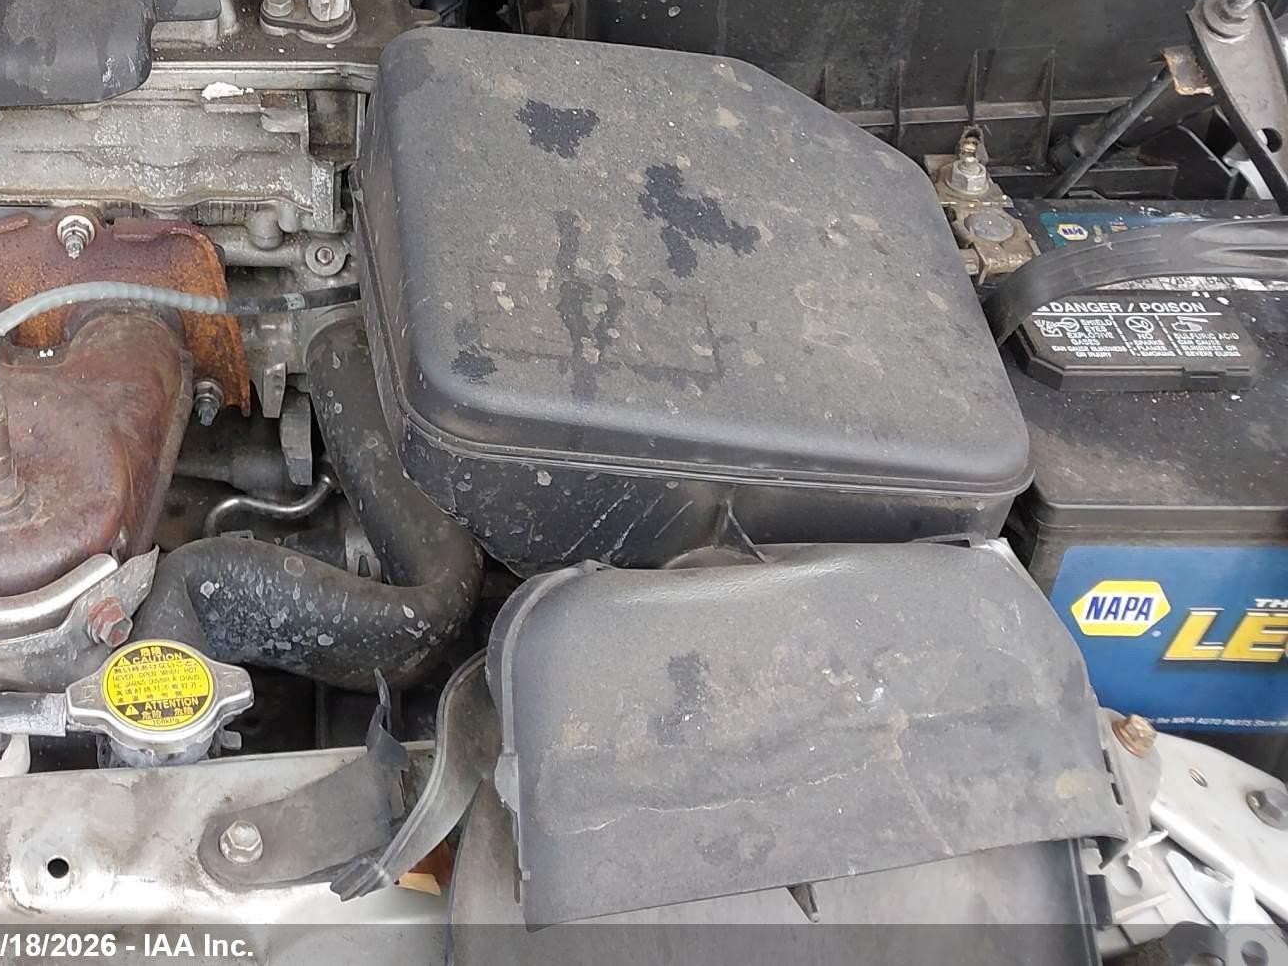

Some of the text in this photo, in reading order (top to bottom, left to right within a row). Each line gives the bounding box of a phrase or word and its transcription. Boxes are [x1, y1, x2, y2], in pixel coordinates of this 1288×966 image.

[1050, 302, 1207, 313] DANGER / POISON
[1085, 596, 1154, 621] NAPA
[132, 652, 183, 663] CAUTION
[113, 672, 131, 682] NEVER
[138, 670, 157, 678] OPEN
[161, 668, 179, 676] WHEN
[144, 698, 199, 711] ATTENTION
[1223, 719, 1253, 727] PARTS
